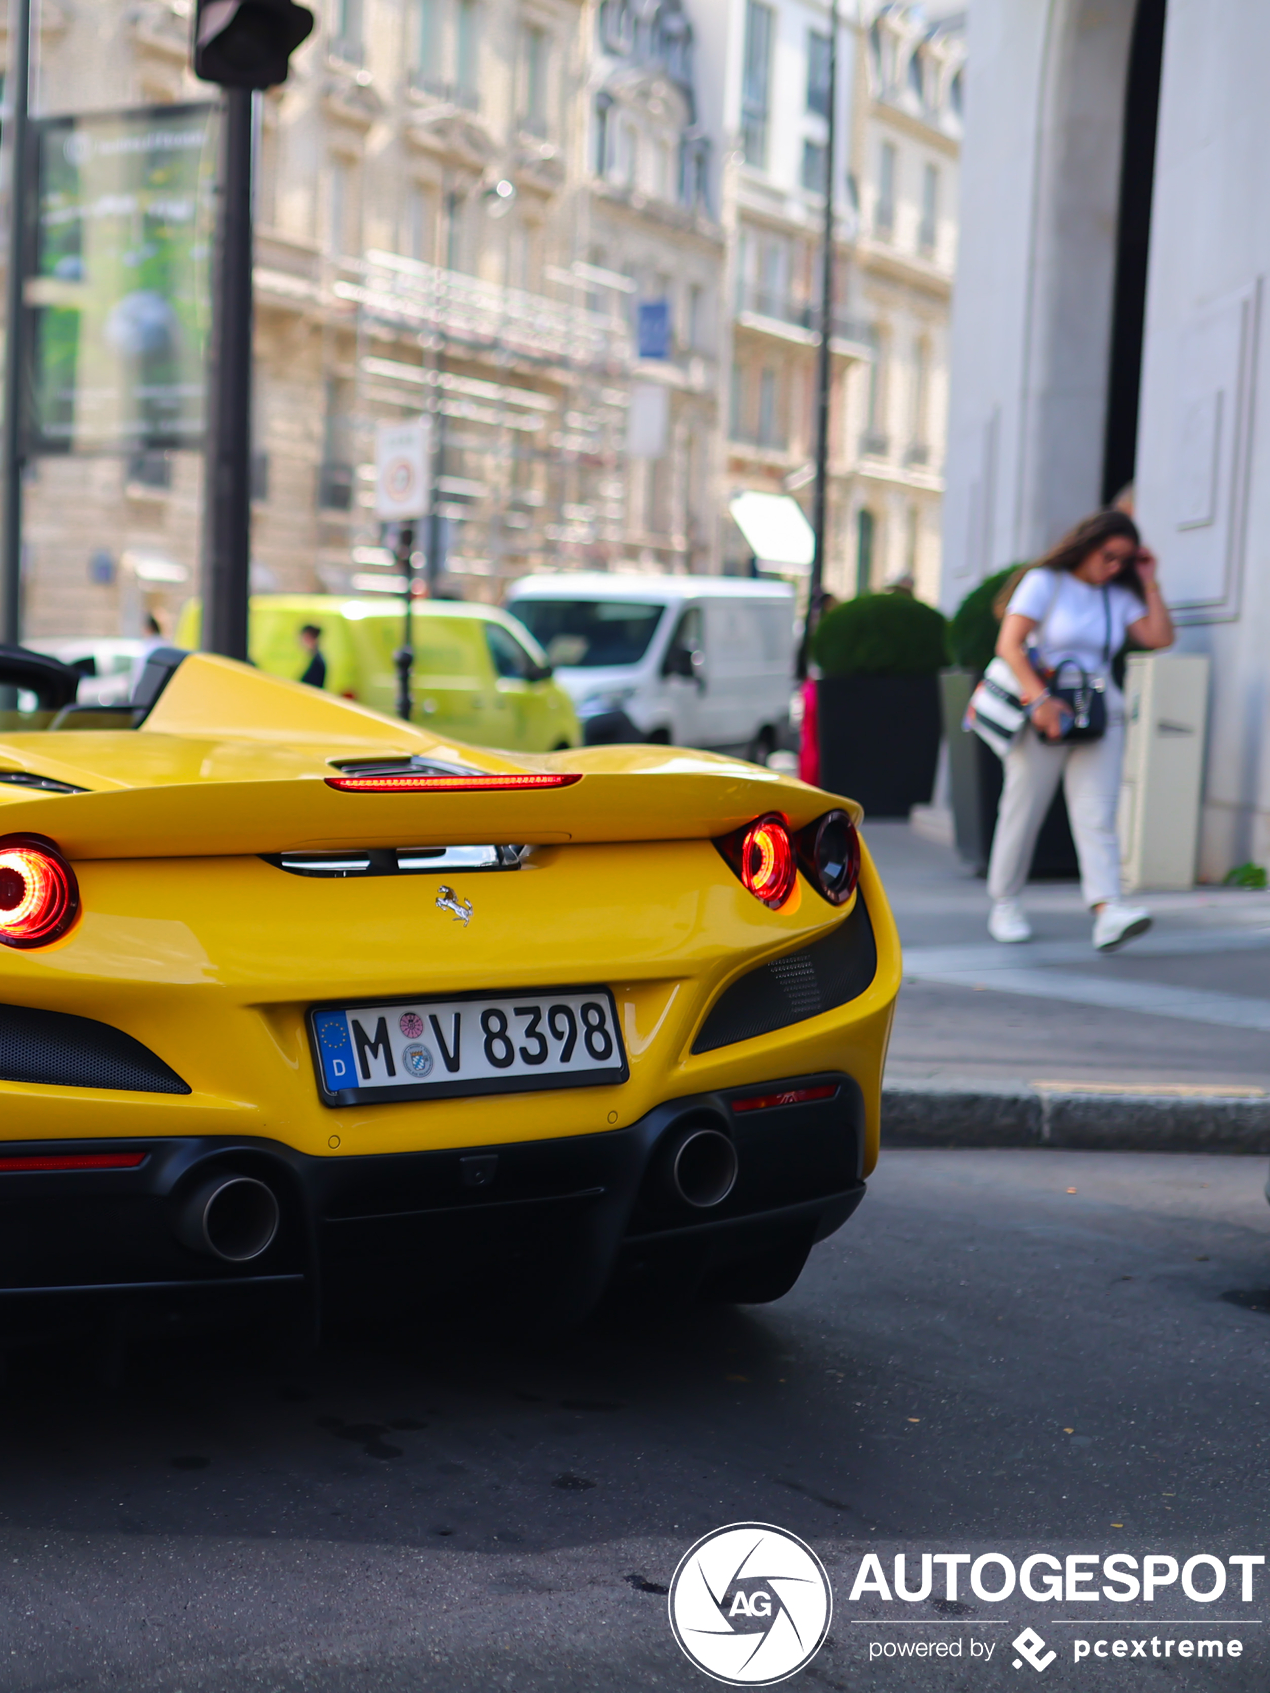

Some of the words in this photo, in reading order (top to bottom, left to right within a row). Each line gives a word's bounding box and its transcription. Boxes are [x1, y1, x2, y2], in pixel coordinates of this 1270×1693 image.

[351, 1016, 397, 1080] M
[428, 1011, 462, 1073] V
[479, 1002, 613, 1069] 8398
[332, 1059, 346, 1077] D
